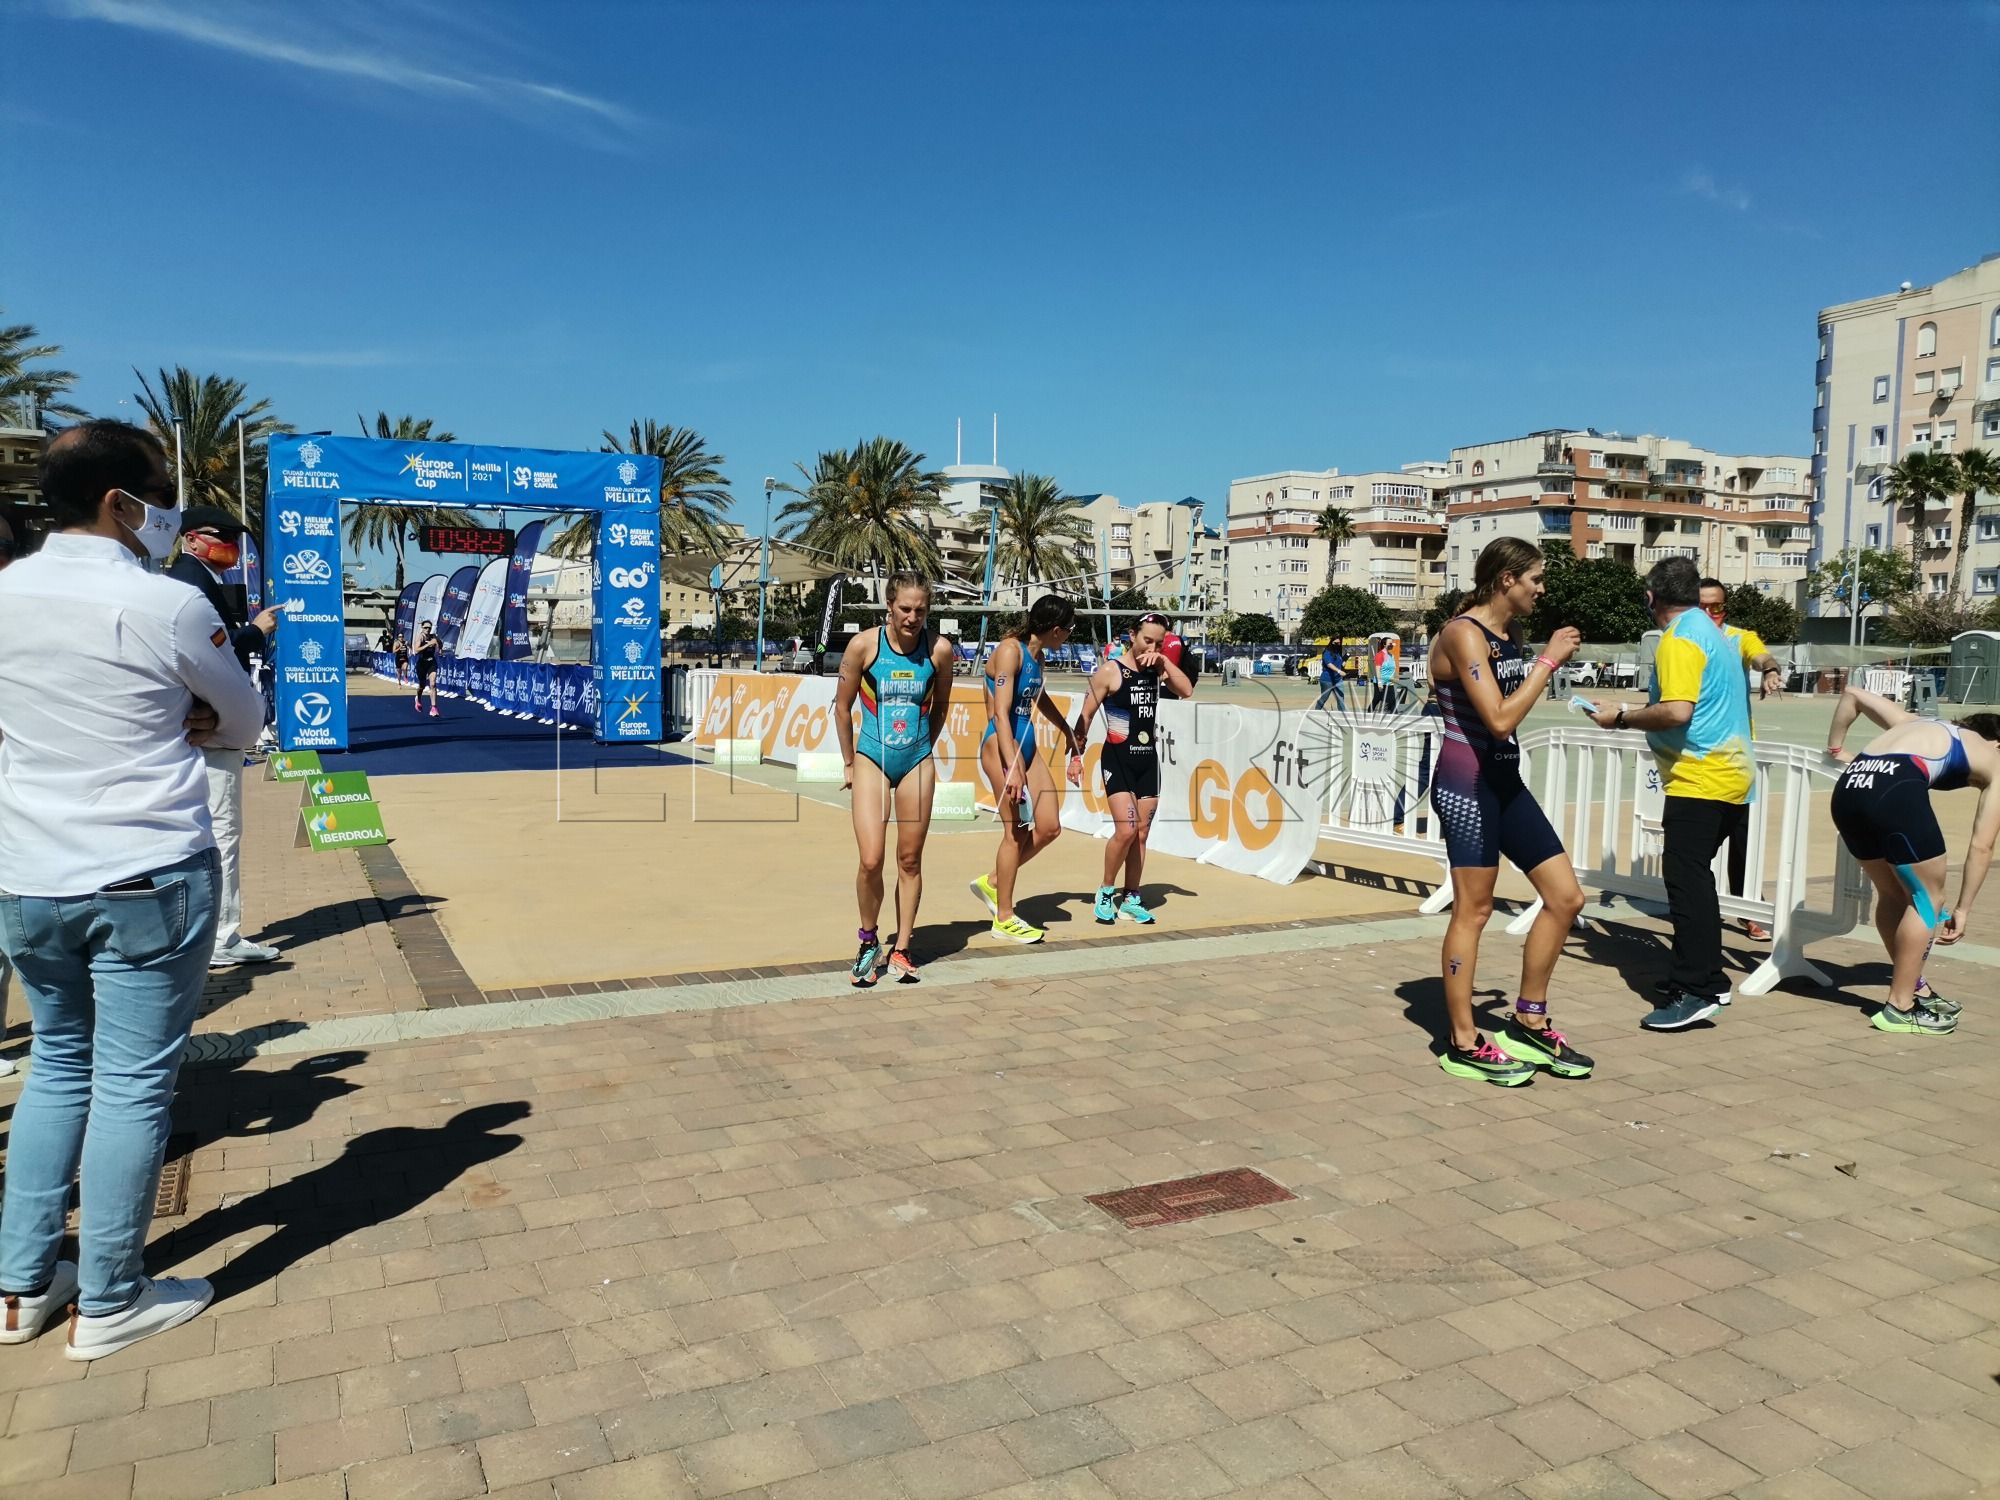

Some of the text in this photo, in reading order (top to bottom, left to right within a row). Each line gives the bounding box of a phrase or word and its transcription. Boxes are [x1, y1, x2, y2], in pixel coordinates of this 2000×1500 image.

[416, 458, 454, 470] Europe
[472, 463, 501, 473] Melilla
[416, 468, 462, 480] Triathlon
[472, 473, 492, 481] 2021
[284, 476, 340, 489] MELILLA
[415, 478, 437, 490] Cup
[605, 492, 652, 504] MELILLA
[304, 516, 334, 524] MELILLA
[608, 561, 656, 589] GO fit
[287, 614, 340, 623] IBERDROLA
[286, 672, 340, 683] MELILLA
[611, 671, 655, 680] MELILLA
[1471, 669, 1480, 681] 1
[879, 681, 924, 695] BARTHELEMY
[996, 678, 1005, 687] 9
[882, 695, 918, 707] BEL
[704, 683, 747, 736] GO fit
[737, 686, 789, 741] GO fit
[1138, 705, 1154, 719] FRA
[620, 721, 648, 729] Europe
[950, 702, 970, 737] fit
[299, 728, 330, 737] World
[617, 728, 651, 736] Triathlon
[785, 703, 830, 752] GO
[293, 737, 337, 746] Triathlon
[1272, 740, 1310, 790] fit
[1846, 759, 1901, 776] CONINX
[281, 768, 323, 778] IBERDROLA
[1845, 773, 1875, 790] FRA
[319, 792, 371, 804] IBERDROLA
[1188, 758, 1284, 851] GO
[319, 828, 384, 844] IBERDROLA
